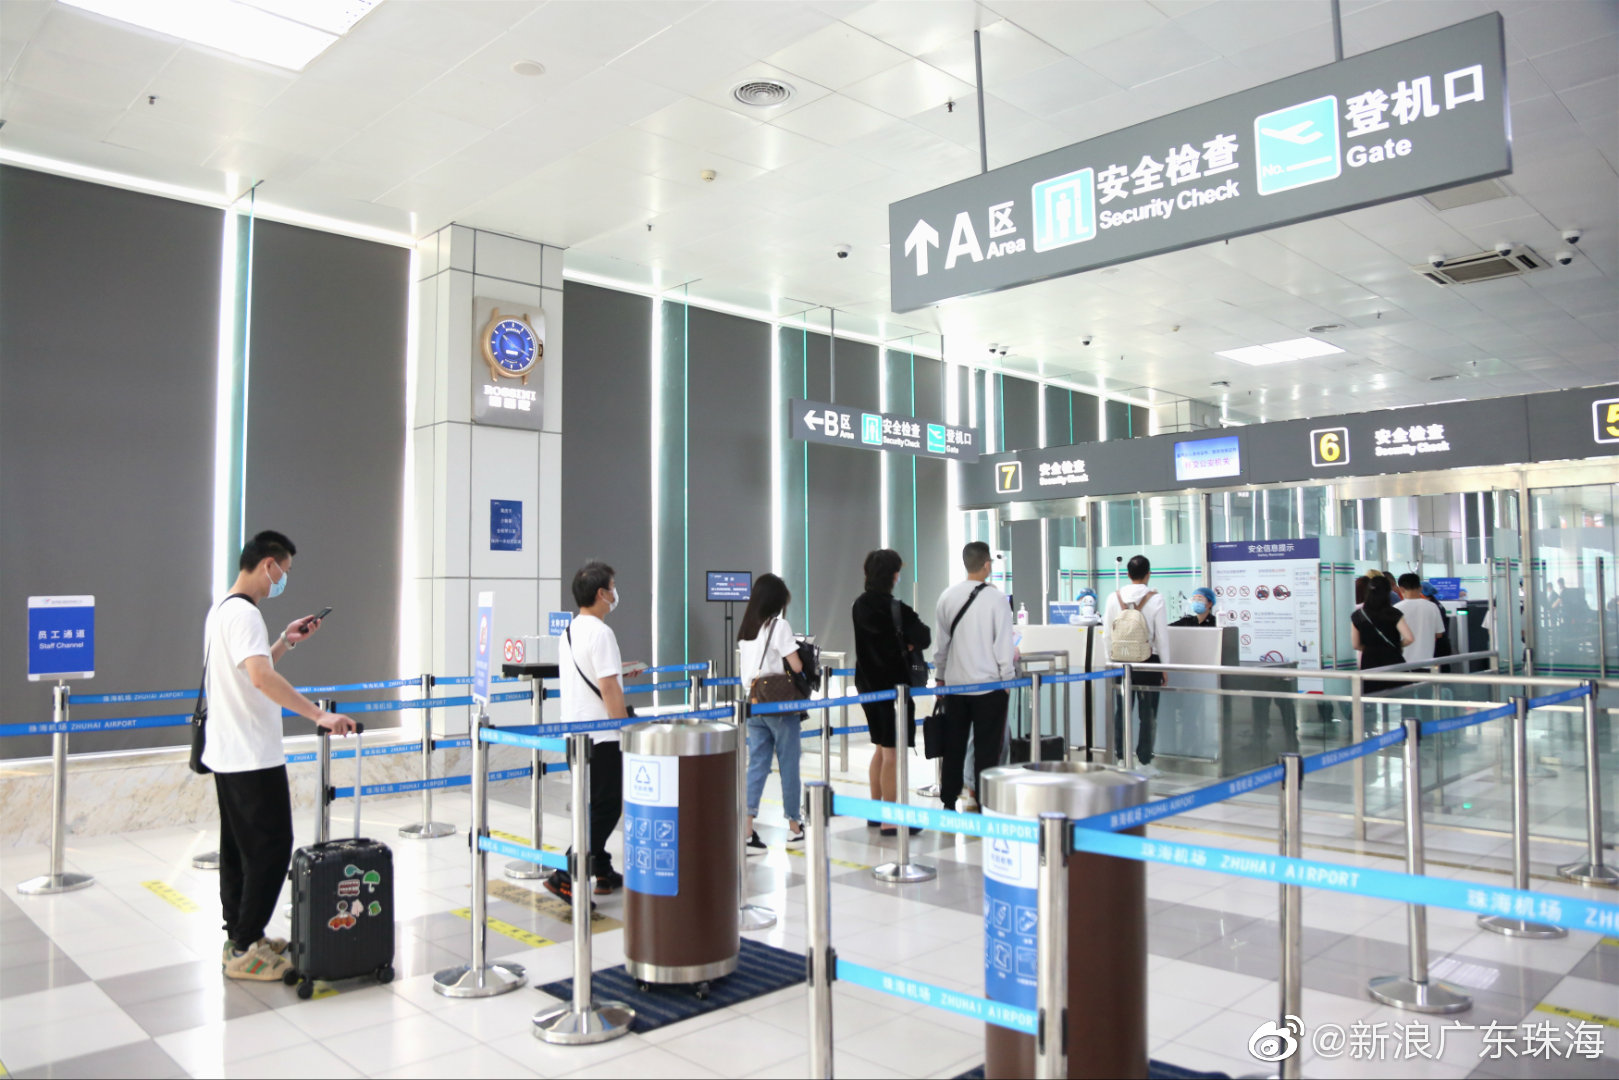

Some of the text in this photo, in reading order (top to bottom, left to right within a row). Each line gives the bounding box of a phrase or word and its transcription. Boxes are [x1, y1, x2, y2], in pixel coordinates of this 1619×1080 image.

[1344, 64, 1485, 138] 登机口
[1347, 136, 1412, 169] Gate
[1096, 133, 1240, 205] 安全检查
[1262, 161, 1285, 178] No.
[1100, 178, 1240, 232] Security Check
[987, 234, 1026, 261] Area
[840, 430, 854, 440] Area
[882, 418, 920, 438] 安全检查
[946, 429, 972, 445] 登机口
[1375, 424, 1445, 446] 安全检查
[1319, 432, 1341, 462] 6
[1001, 465, 1016, 489] 7
[1248, 543, 1295, 554] 安全信息提示
[38, 629, 85, 640] 员工通道
[398, 700, 420, 708] ZHUHAI
[421, 699, 447, 707] AIRPORT
[29, 719, 137, 732] 珠海机场 ZHUHAI AIRPORT
[570, 722, 594, 731] ZHUHAI
[596, 720, 622, 728] AIRPORT
[399, 783, 420, 791] ZHUHAI
[422, 780, 447, 788] AIRPORT
[1144, 802, 1168, 818] ZHUHAI
[1170, 794, 1195, 811] AIRPORT
[881, 806, 1038, 840] 珠海机场 ZHUHAI AIRPORT
[1141, 842, 1361, 889] 珠海机场 ZHUHAI AIRPORT
[1467, 889, 1563, 922] 珠海机场
[882, 976, 1038, 1027] 珠海机场 ZHUHAI AIRPOR
